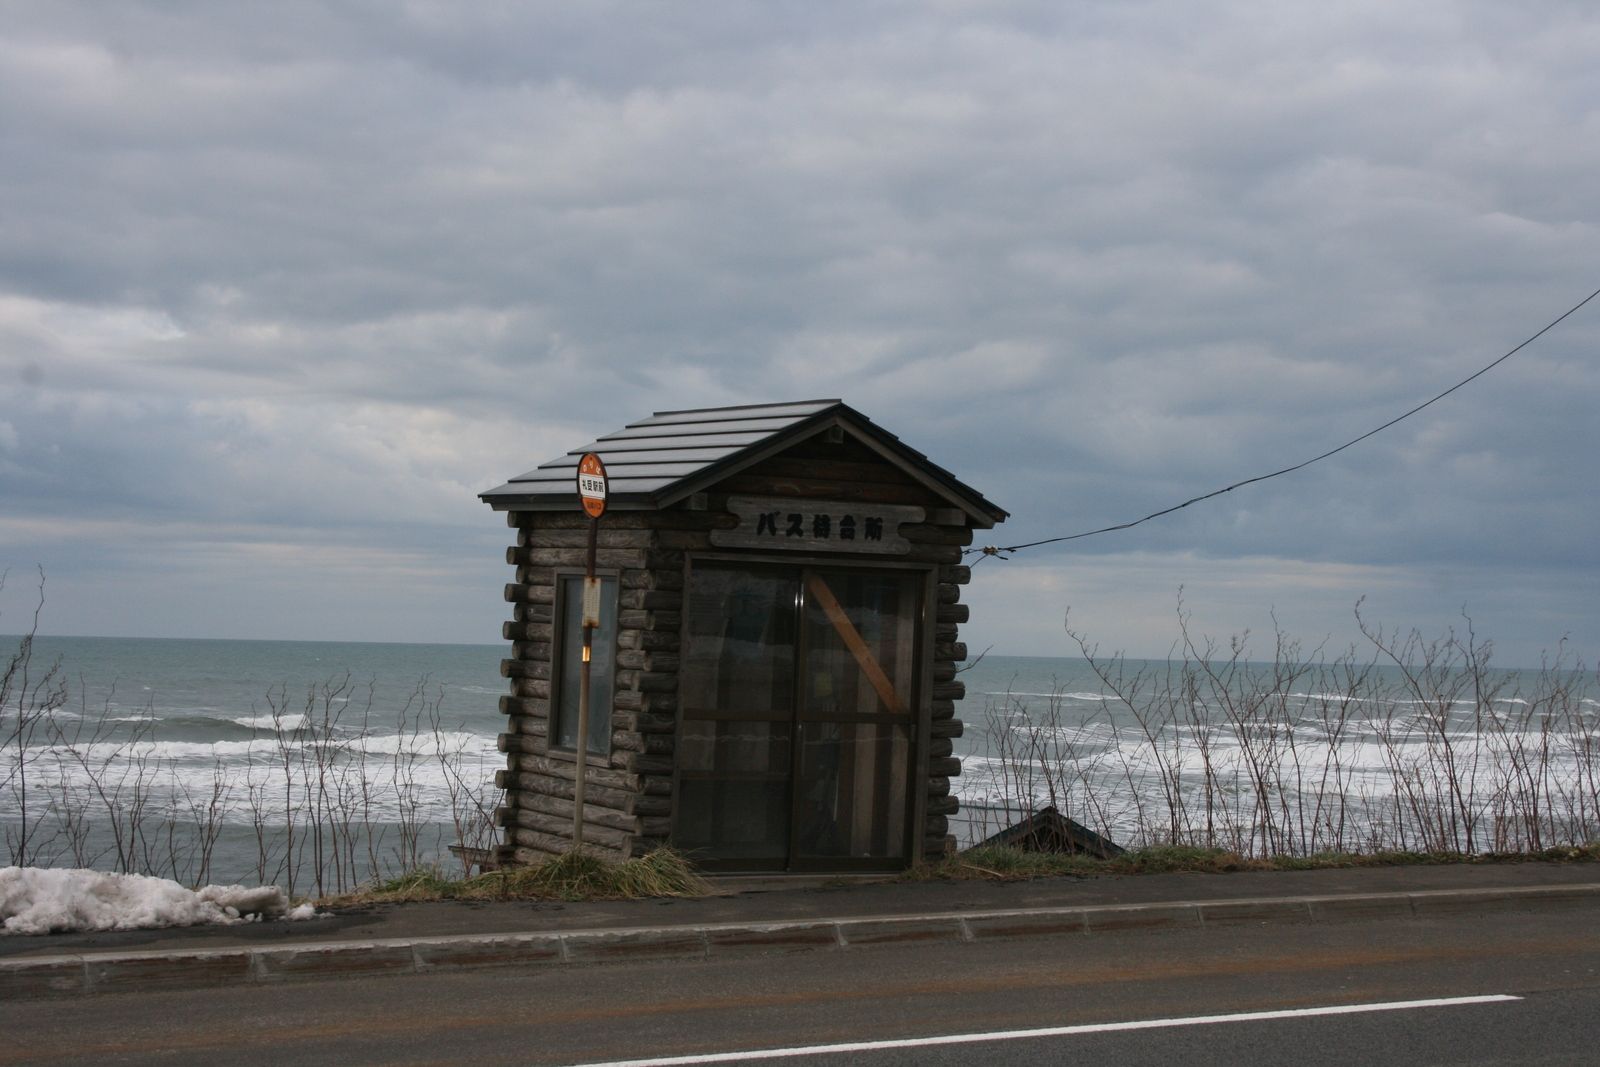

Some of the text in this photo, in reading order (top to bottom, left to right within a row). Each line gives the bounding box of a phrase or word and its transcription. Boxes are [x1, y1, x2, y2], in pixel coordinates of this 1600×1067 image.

[756, 510, 884, 541] バス待合所
